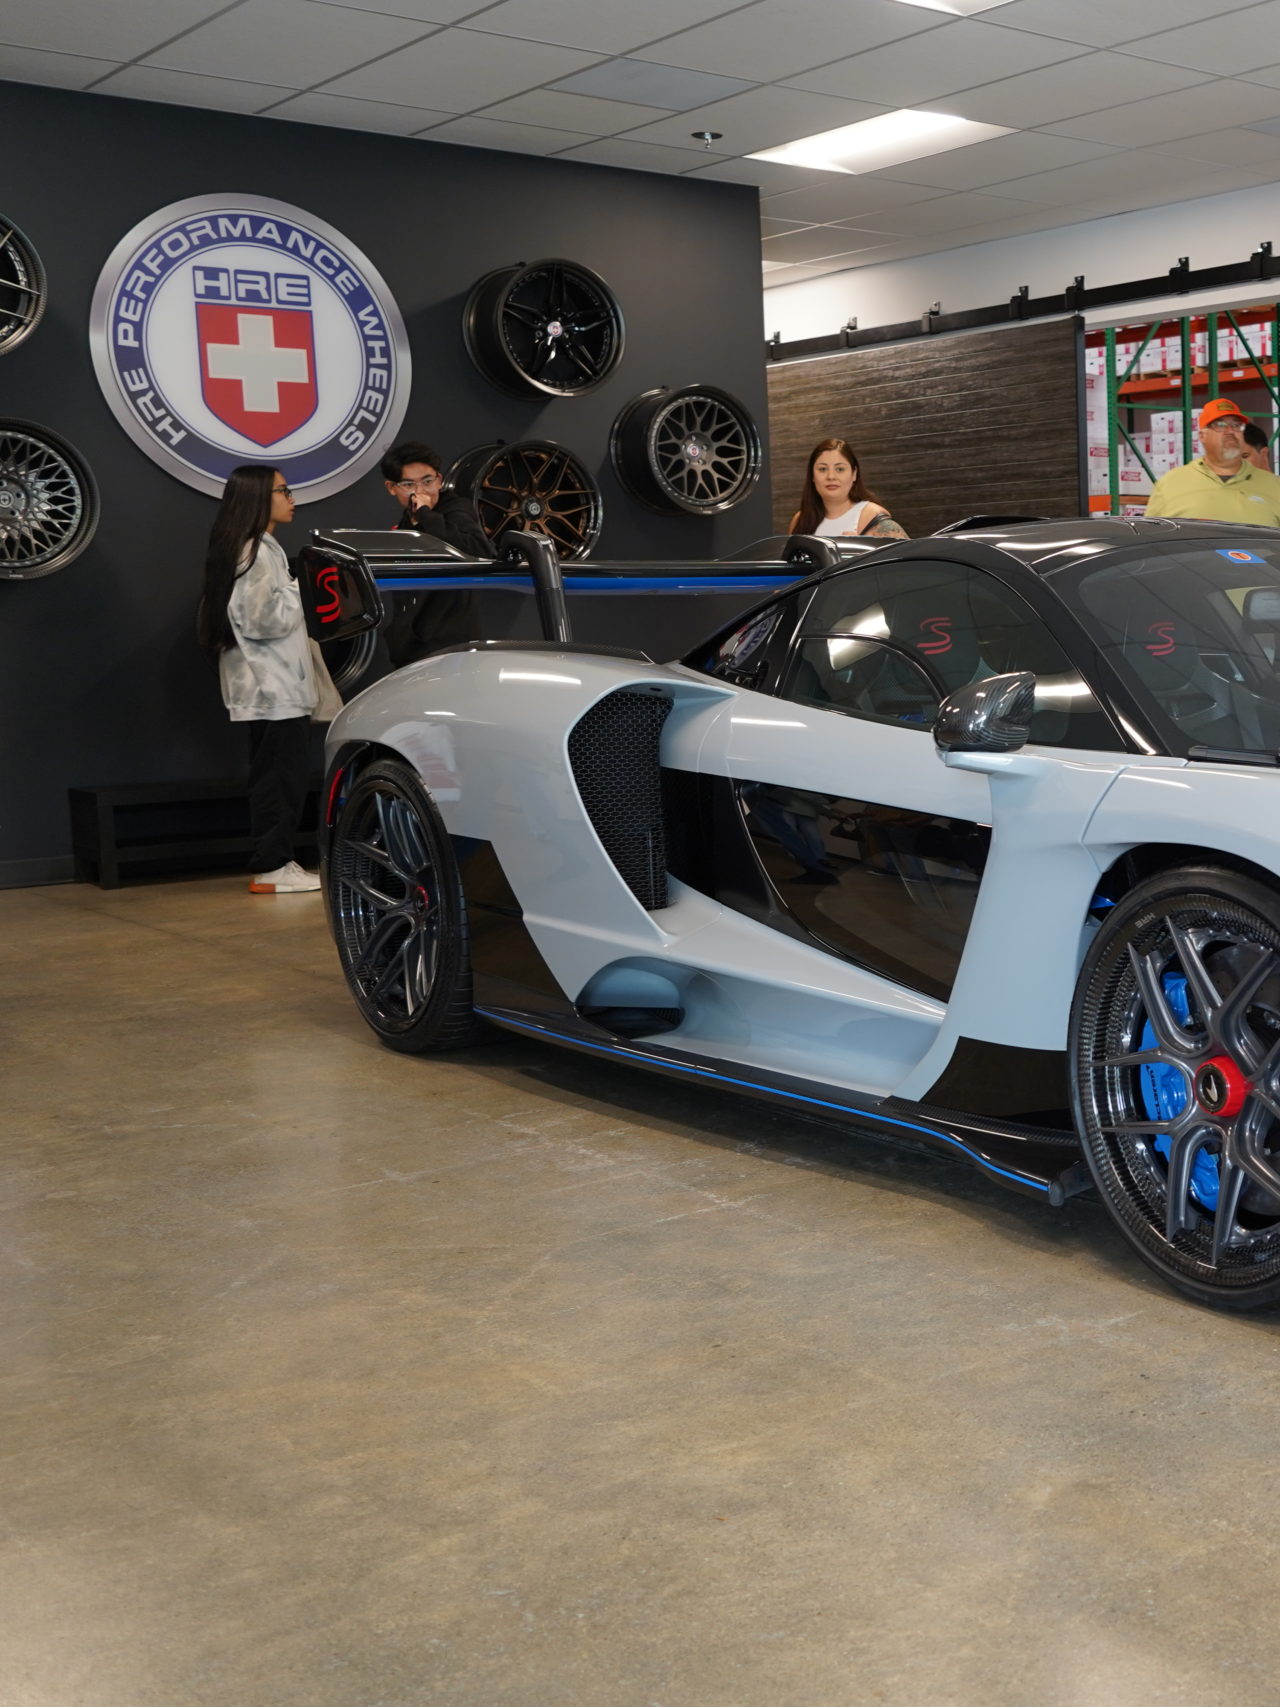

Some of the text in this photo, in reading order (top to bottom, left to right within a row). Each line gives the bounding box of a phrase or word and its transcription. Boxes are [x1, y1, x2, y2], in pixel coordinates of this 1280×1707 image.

[118, 217, 388, 451] HRE PERFORMANCE WHEELS
[193, 268, 310, 304] HRE
